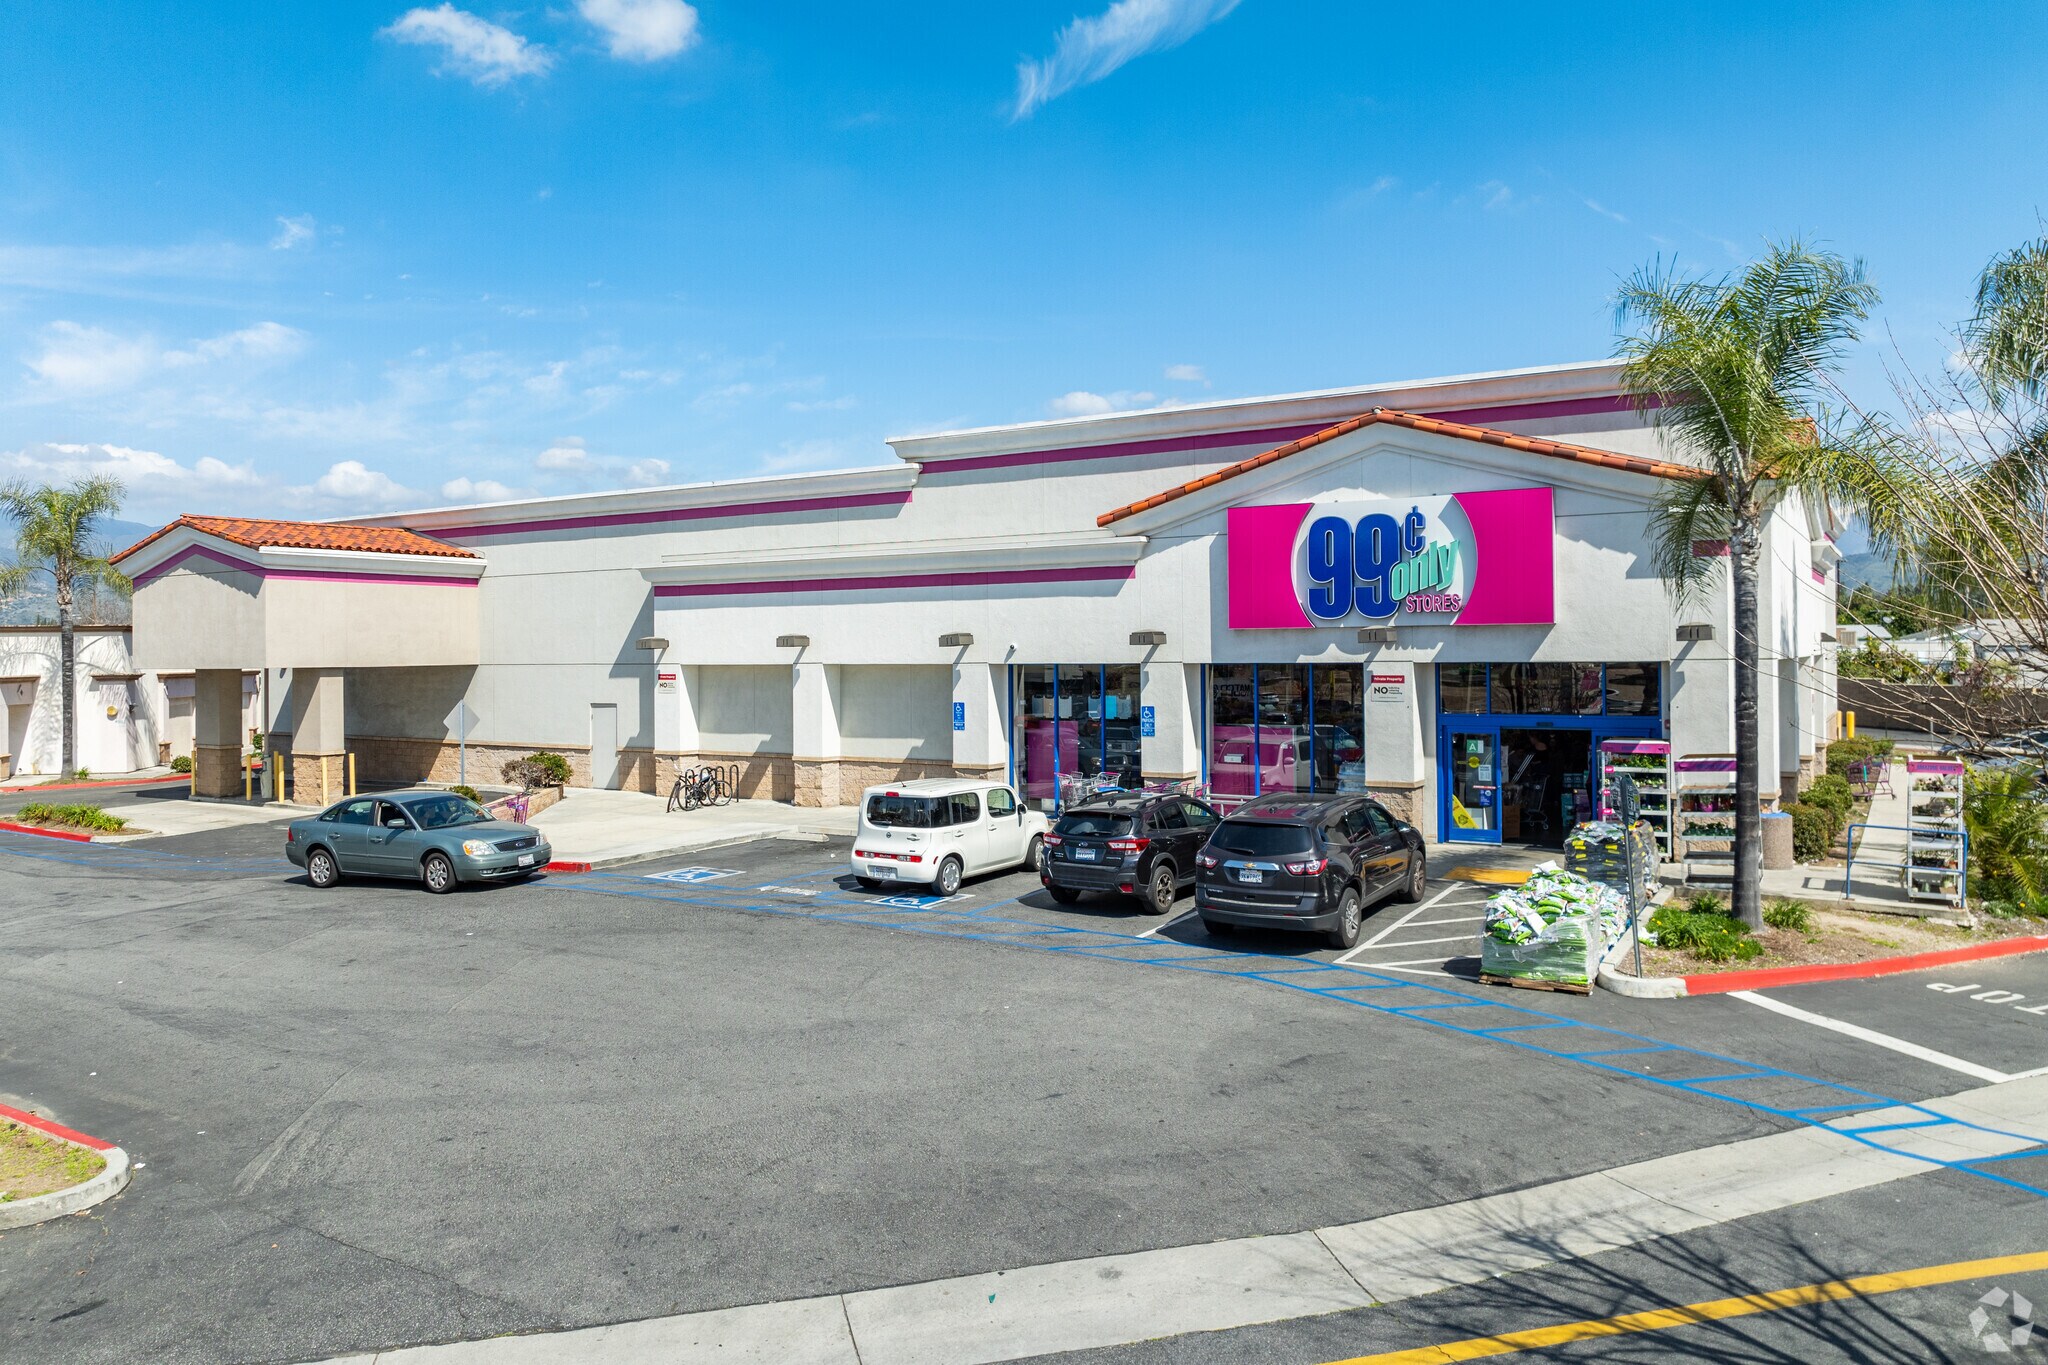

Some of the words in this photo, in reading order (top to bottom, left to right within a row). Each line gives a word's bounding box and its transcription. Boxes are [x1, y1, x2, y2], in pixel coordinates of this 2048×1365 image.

[1389, 540, 1460, 601] only
[1405, 593, 1462, 613] STORES
[1374, 686, 1388, 694] NO
[1469, 743, 1477, 751] A
